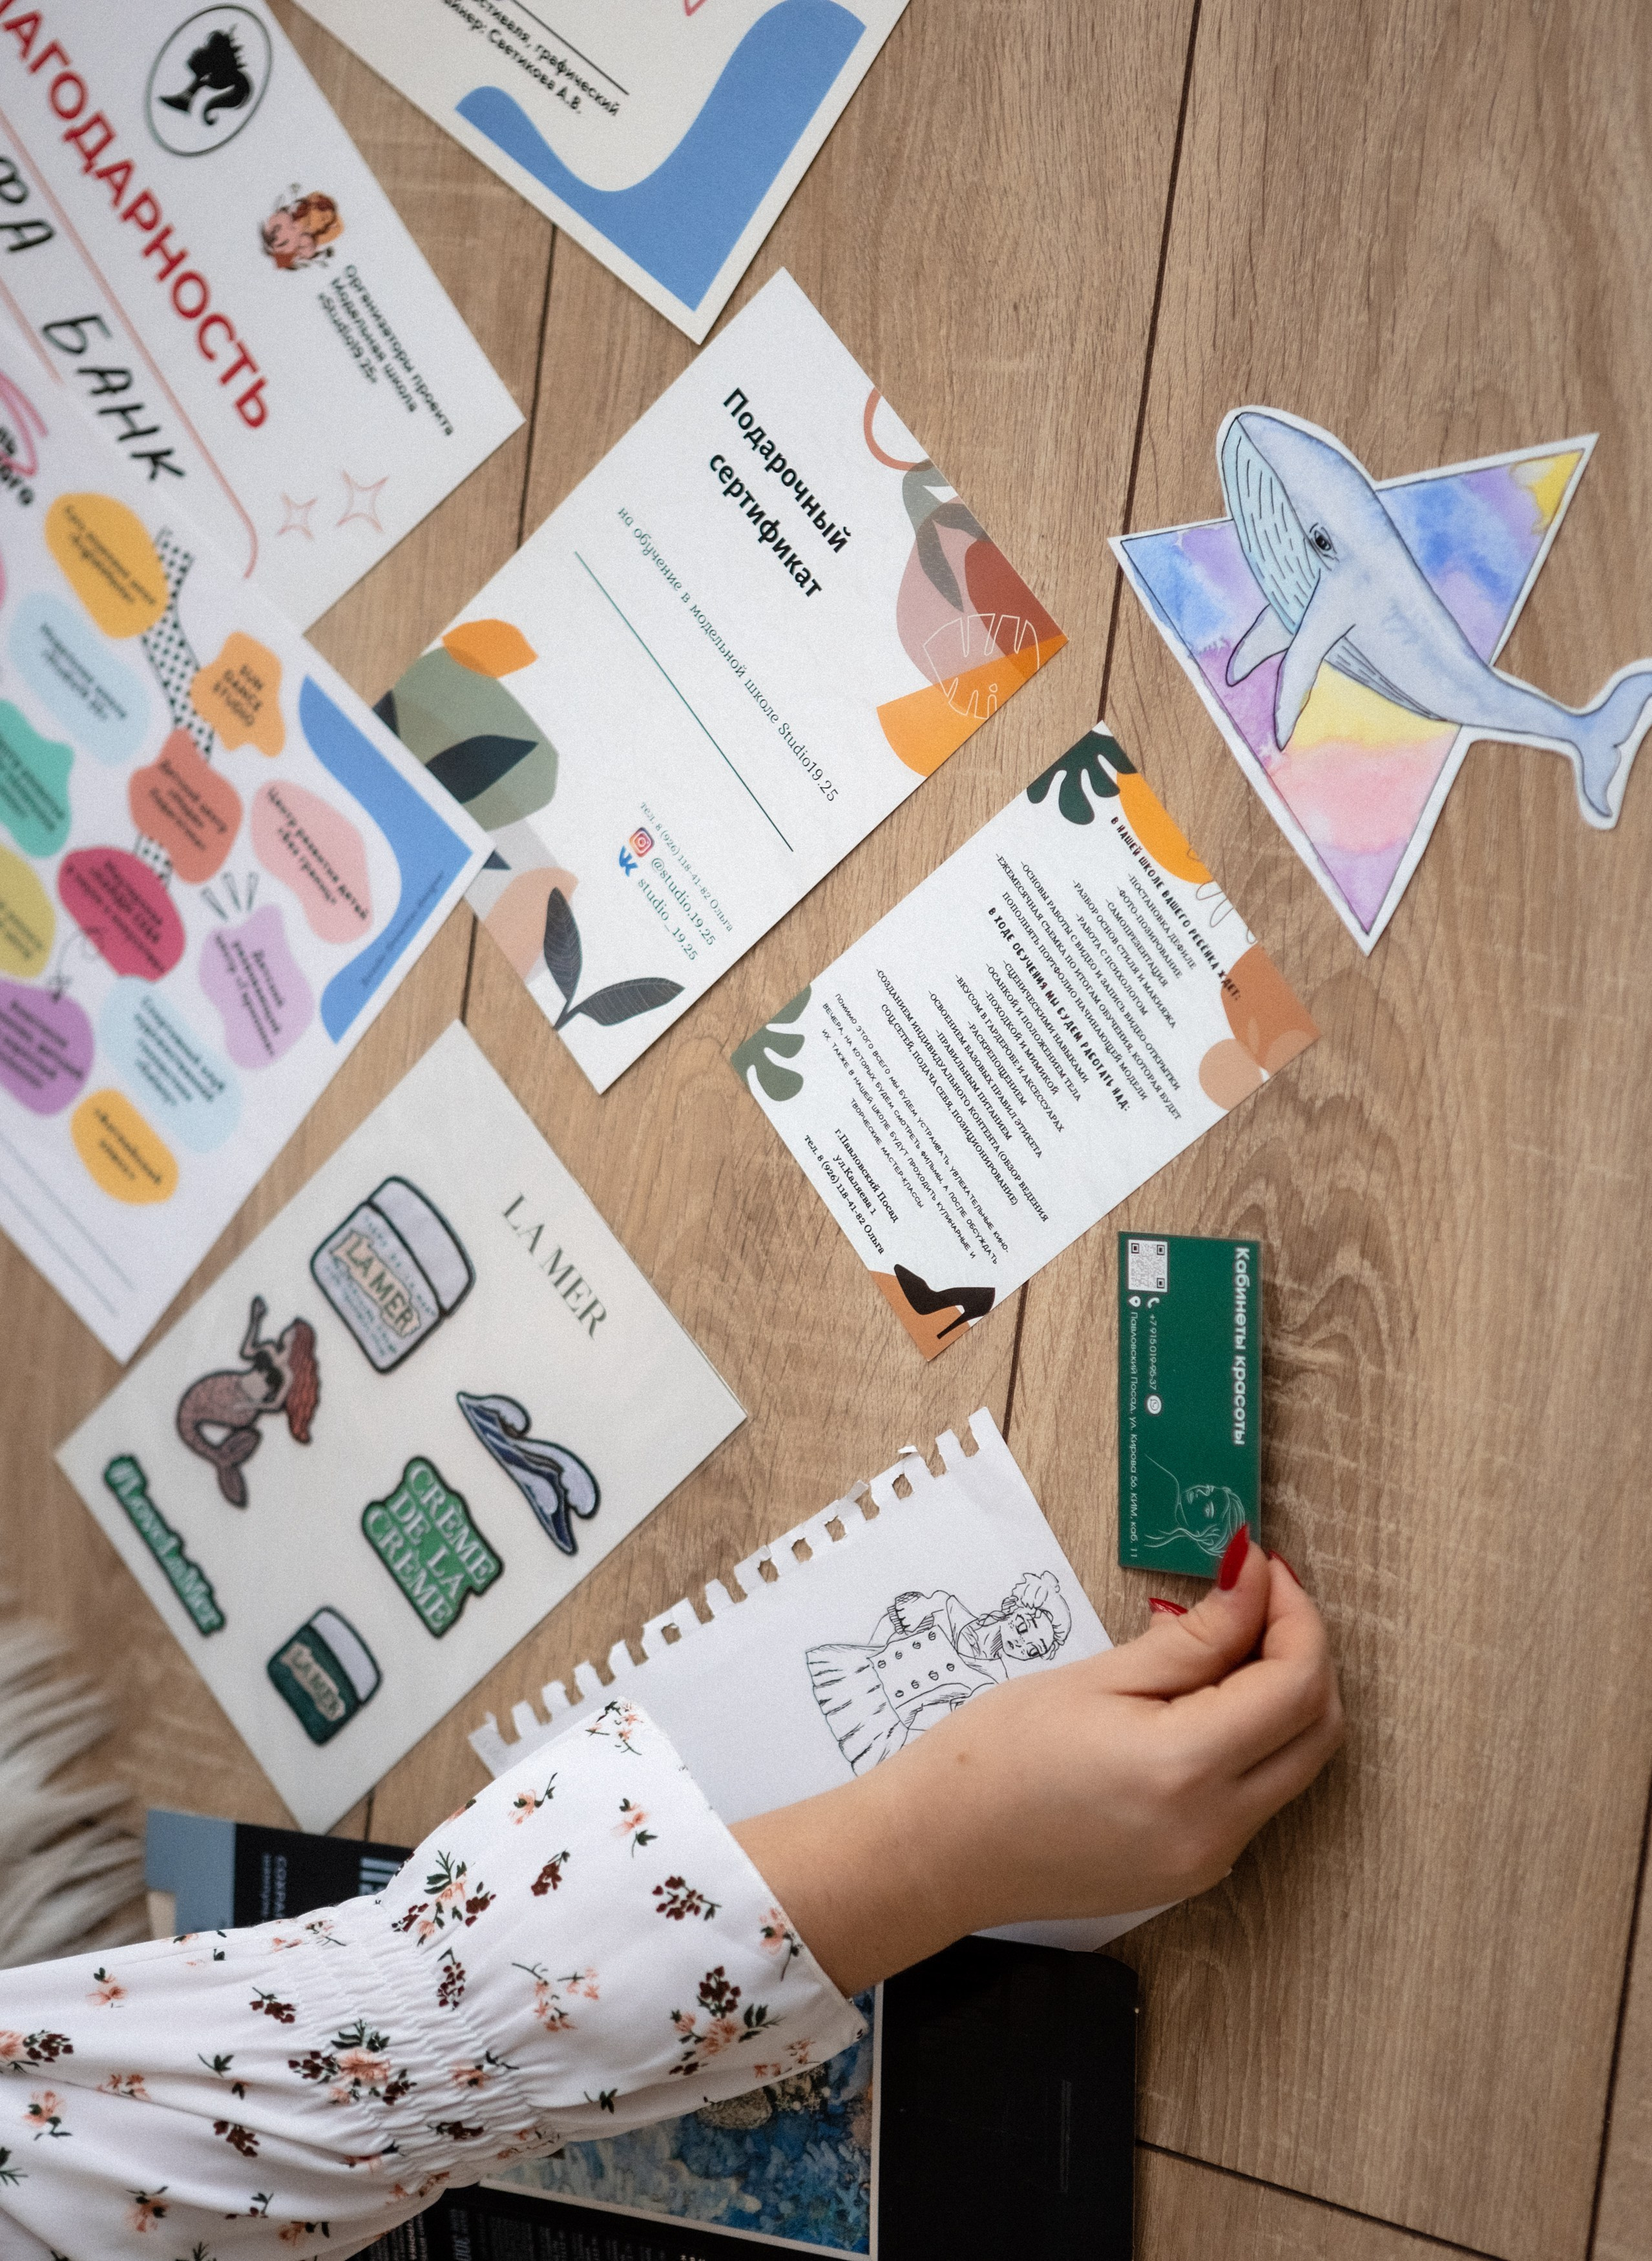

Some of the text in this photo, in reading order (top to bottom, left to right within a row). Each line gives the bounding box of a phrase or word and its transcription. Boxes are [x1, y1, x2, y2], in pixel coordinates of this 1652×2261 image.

[471, 0, 621, 117] стиваля, графический
[486, 28, 558, 91] Светикова
[43, 315, 183, 479] БАНК
[330, 277, 417, 413] Модельная школа
[345, 264, 454, 437] Организаторы проекта
[709, 453, 823, 598] сертификат
[722, 387, 852, 554] Подарочный
[617, 506, 839, 802] на обучение в модельной школе Studio19.25
[654, 823, 663, 832] 8
[660, 829, 681, 857] (926)
[677, 854, 711, 901] 118-41-82
[709, 899, 733, 933] Ольга
[1110, 815, 1120, 826] В
[1116, 824, 1143, 857] НАШЕЙ
[1138, 855, 1165, 890] ШКОЛЕ
[1161, 889, 1191, 928] ВАШЕГО
[1217, 969, 1241, 1001] ЖДЕТ:
[987, 906, 1131, 1112] В ХОДЕ ОБУЧЕНИЯ МЫ БУДЕМ РАБОТАТЬ НАД:
[1001, 891, 1149, 1101] ПОПОЛНЯТЬ ПОРТФОЛИО НАЧИНАЮЩЕЙ МОДЕЛИ
[1046, 899, 1074, 936] РАБОТЫ
[1070, 934, 1078, 943] С
[1074, 940, 1098, 971] ВИДЕО
[1094, 969, 1104, 979] И
[1100, 977, 1126, 1013] ЗАПИСЬ
[1123, 1011, 1181, 1091] ВИДЕО-ОТКРЫТКИ
[1166, 932, 1197, 970] ДЕФИЛЕ
[979, 1011, 988, 1020] В
[984, 1017, 1020, 1067] ГАРДЕРОБЕ
[1016, 1064, 1025, 1075] И
[1021, 1073, 1065, 1133] АКСЕССУАРАХ
[1018, 1039, 1028, 1050] И
[1023, 1047, 1060, 1096] МИМИКОЙ
[1052, 1032, 1090, 1084] НАВЫКАМИ
[1064, 953, 1077, 970] ПО
[1073, 967, 1102, 1005] ИТОГАМ
[1098, 1003, 1134, 1054] ОБУЧЕНИЯ,
[1131, 1051, 1163, 1094] КОТОРАЯ
[1158, 1091, 1182, 1120] БУДЕТ
[835, 993, 857, 1025] ПОМИМО
[855, 1025, 874, 1050] ЭТОГО
[872, 1050, 891, 1075] ВСЕГО
[888, 1076, 901, 1090] МЫ
[898, 1089, 918, 1118] БУДЕМ
[916, 1116, 950, 1166] УСТРАИВАТЬ
[949, 1165, 995, 1231] УВЛЕКАТЕЛЬНЫЕ
[843, 1034, 853, 1047] НА
[852, 1047, 877, 1083] КОТОРЫХ
[875, 1081, 895, 1110] БУДЕМ
[894, 1109, 921, 1150] СМОТРЕТЬ
[948, 1191, 968, 1218] ПОСЛЕ
[966, 1218, 998, 1265] ОБСУЖДАТЬ
[850, 1097, 925, 1209] ТВОРЧЕСКИЕ МАСТЕР-КЛАССЫ
[910, 1020, 971, 1107] ИНДИВИДУАЛЬНОГО
[967, 1105, 1001, 1153] КОНТЕНТА
[997, 1151, 1022, 1182] (ОБЗОР
[1018, 1180, 1049, 1223] ВЕДЕНИЯ
[912, 1050, 938, 1088] ПОДАЧА
[935, 1085, 954, 1112] СЕБЯ,
[950, 1109, 1019, 1206] ПОЗИЦИОНИРОВАНИЕ)
[963, 1043, 994, 1086] БАЗОВЫХ
[990, 1083, 1018, 1120] ПРАВИЛ
[1014, 1118, 1043, 1159] ЭТИКЕТА
[976, 1090, 1013, 1141] ПИТАНИЕМ
[804, 1134, 884, 1255] тел. 8 (926) 118-41-82 Ольга
[869, 1207, 877, 1216] 1
[876, 1191, 899, 1224] Посад
[344, 1233, 382, 1279] LA
[368, 1266, 421, 1337] MER
[501, 1191, 607, 1340] LA MER
[1149, 1313, 1157, 1327] +7
[1129, 1311, 1138, 1375] Павловский
[1129, 1376, 1138, 1415] Посад,
[1149, 1345, 1157, 1391] 019-95-37
[1231, 1247, 1250, 1445] Кабинеты красоты
[1129, 1433, 1138, 1474] Кирова
[1129, 1492, 1138, 1519] КИМ,
[389, 1489, 465, 1601] DE LA
[1129, 1521, 1138, 1543] каб.
[1130, 1548, 1138, 1558] 11
